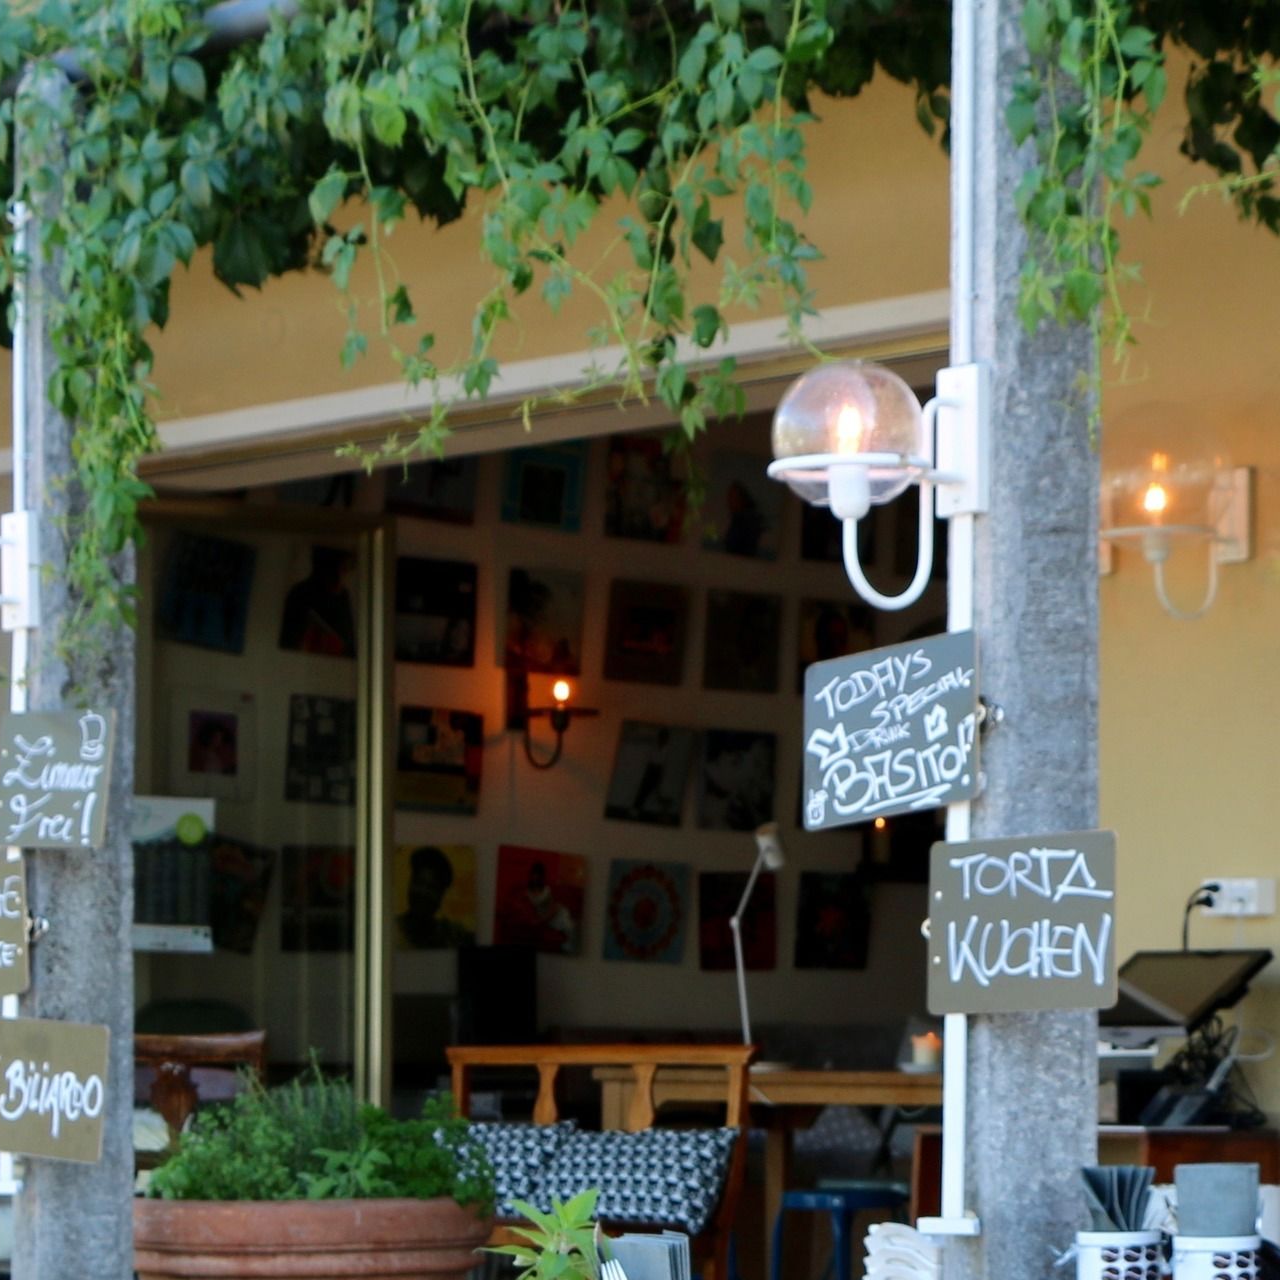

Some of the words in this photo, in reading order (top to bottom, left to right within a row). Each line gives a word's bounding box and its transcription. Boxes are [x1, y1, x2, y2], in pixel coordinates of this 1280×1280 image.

[814, 649, 932, 719] TODAYS
[871, 666, 975, 729] SPECIAL
[949, 848, 1113, 902] TORTA
[948, 912, 1112, 987] KUCHEN
